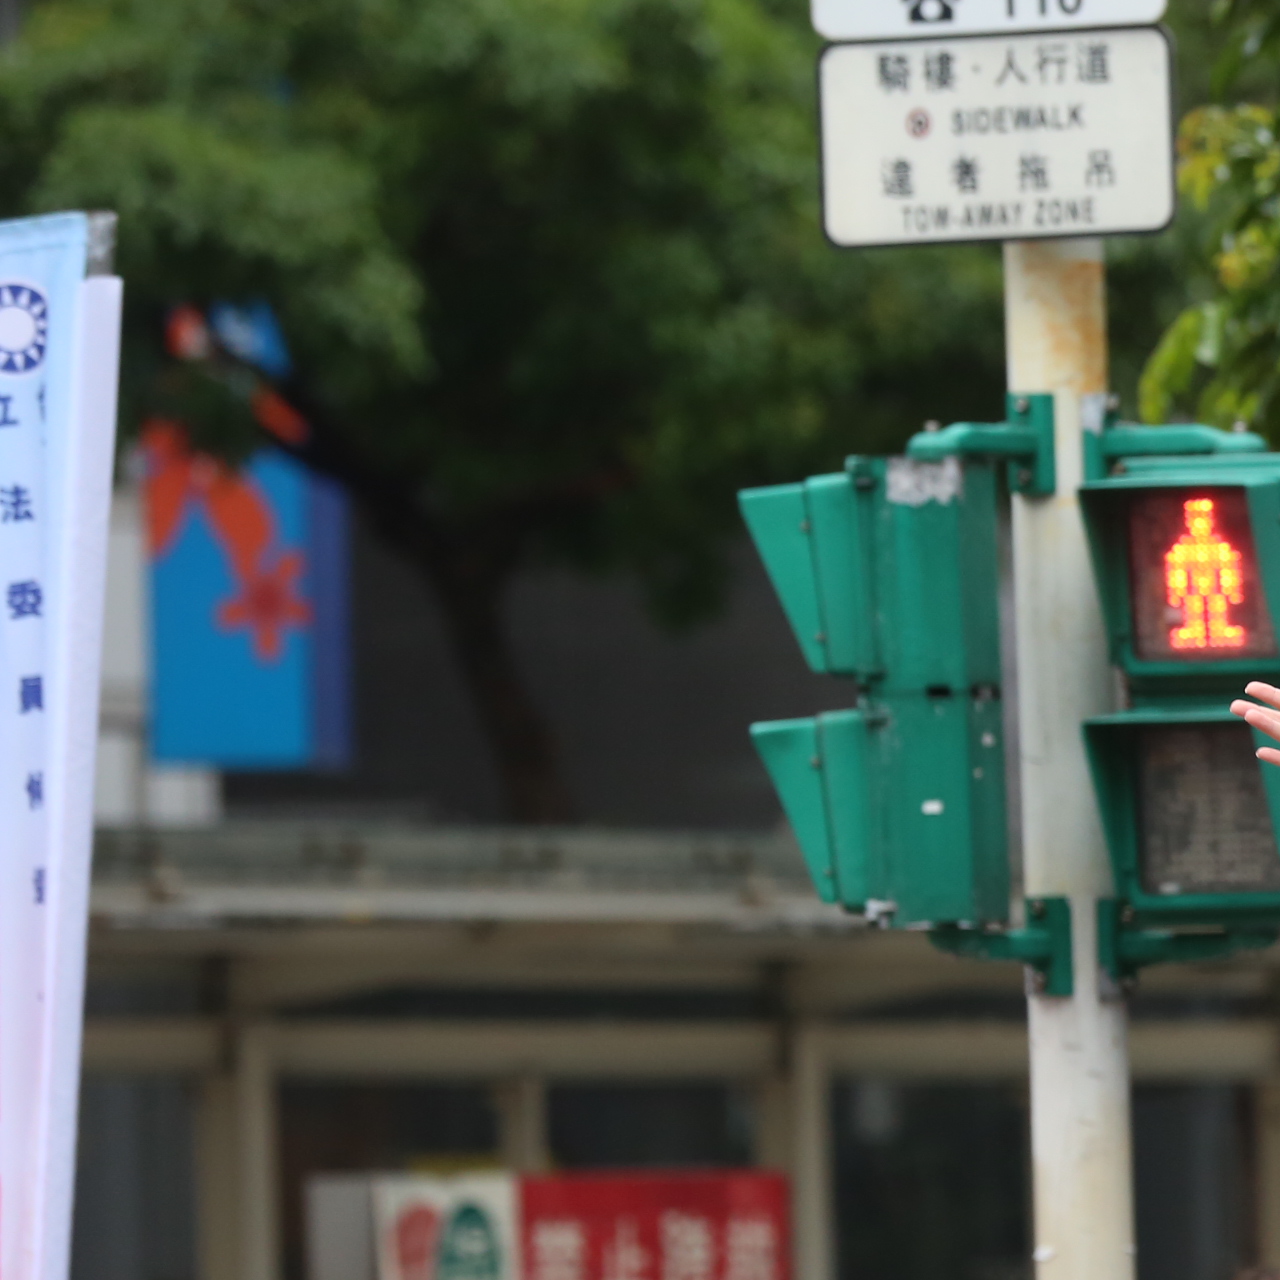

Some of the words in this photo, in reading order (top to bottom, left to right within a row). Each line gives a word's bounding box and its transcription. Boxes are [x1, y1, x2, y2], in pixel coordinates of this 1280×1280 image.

[952, 105, 1086, 136] SIDEWALK
[901, 202, 1023, 233] TOW-AWAY
[1034, 197, 1095, 225] ZONE
